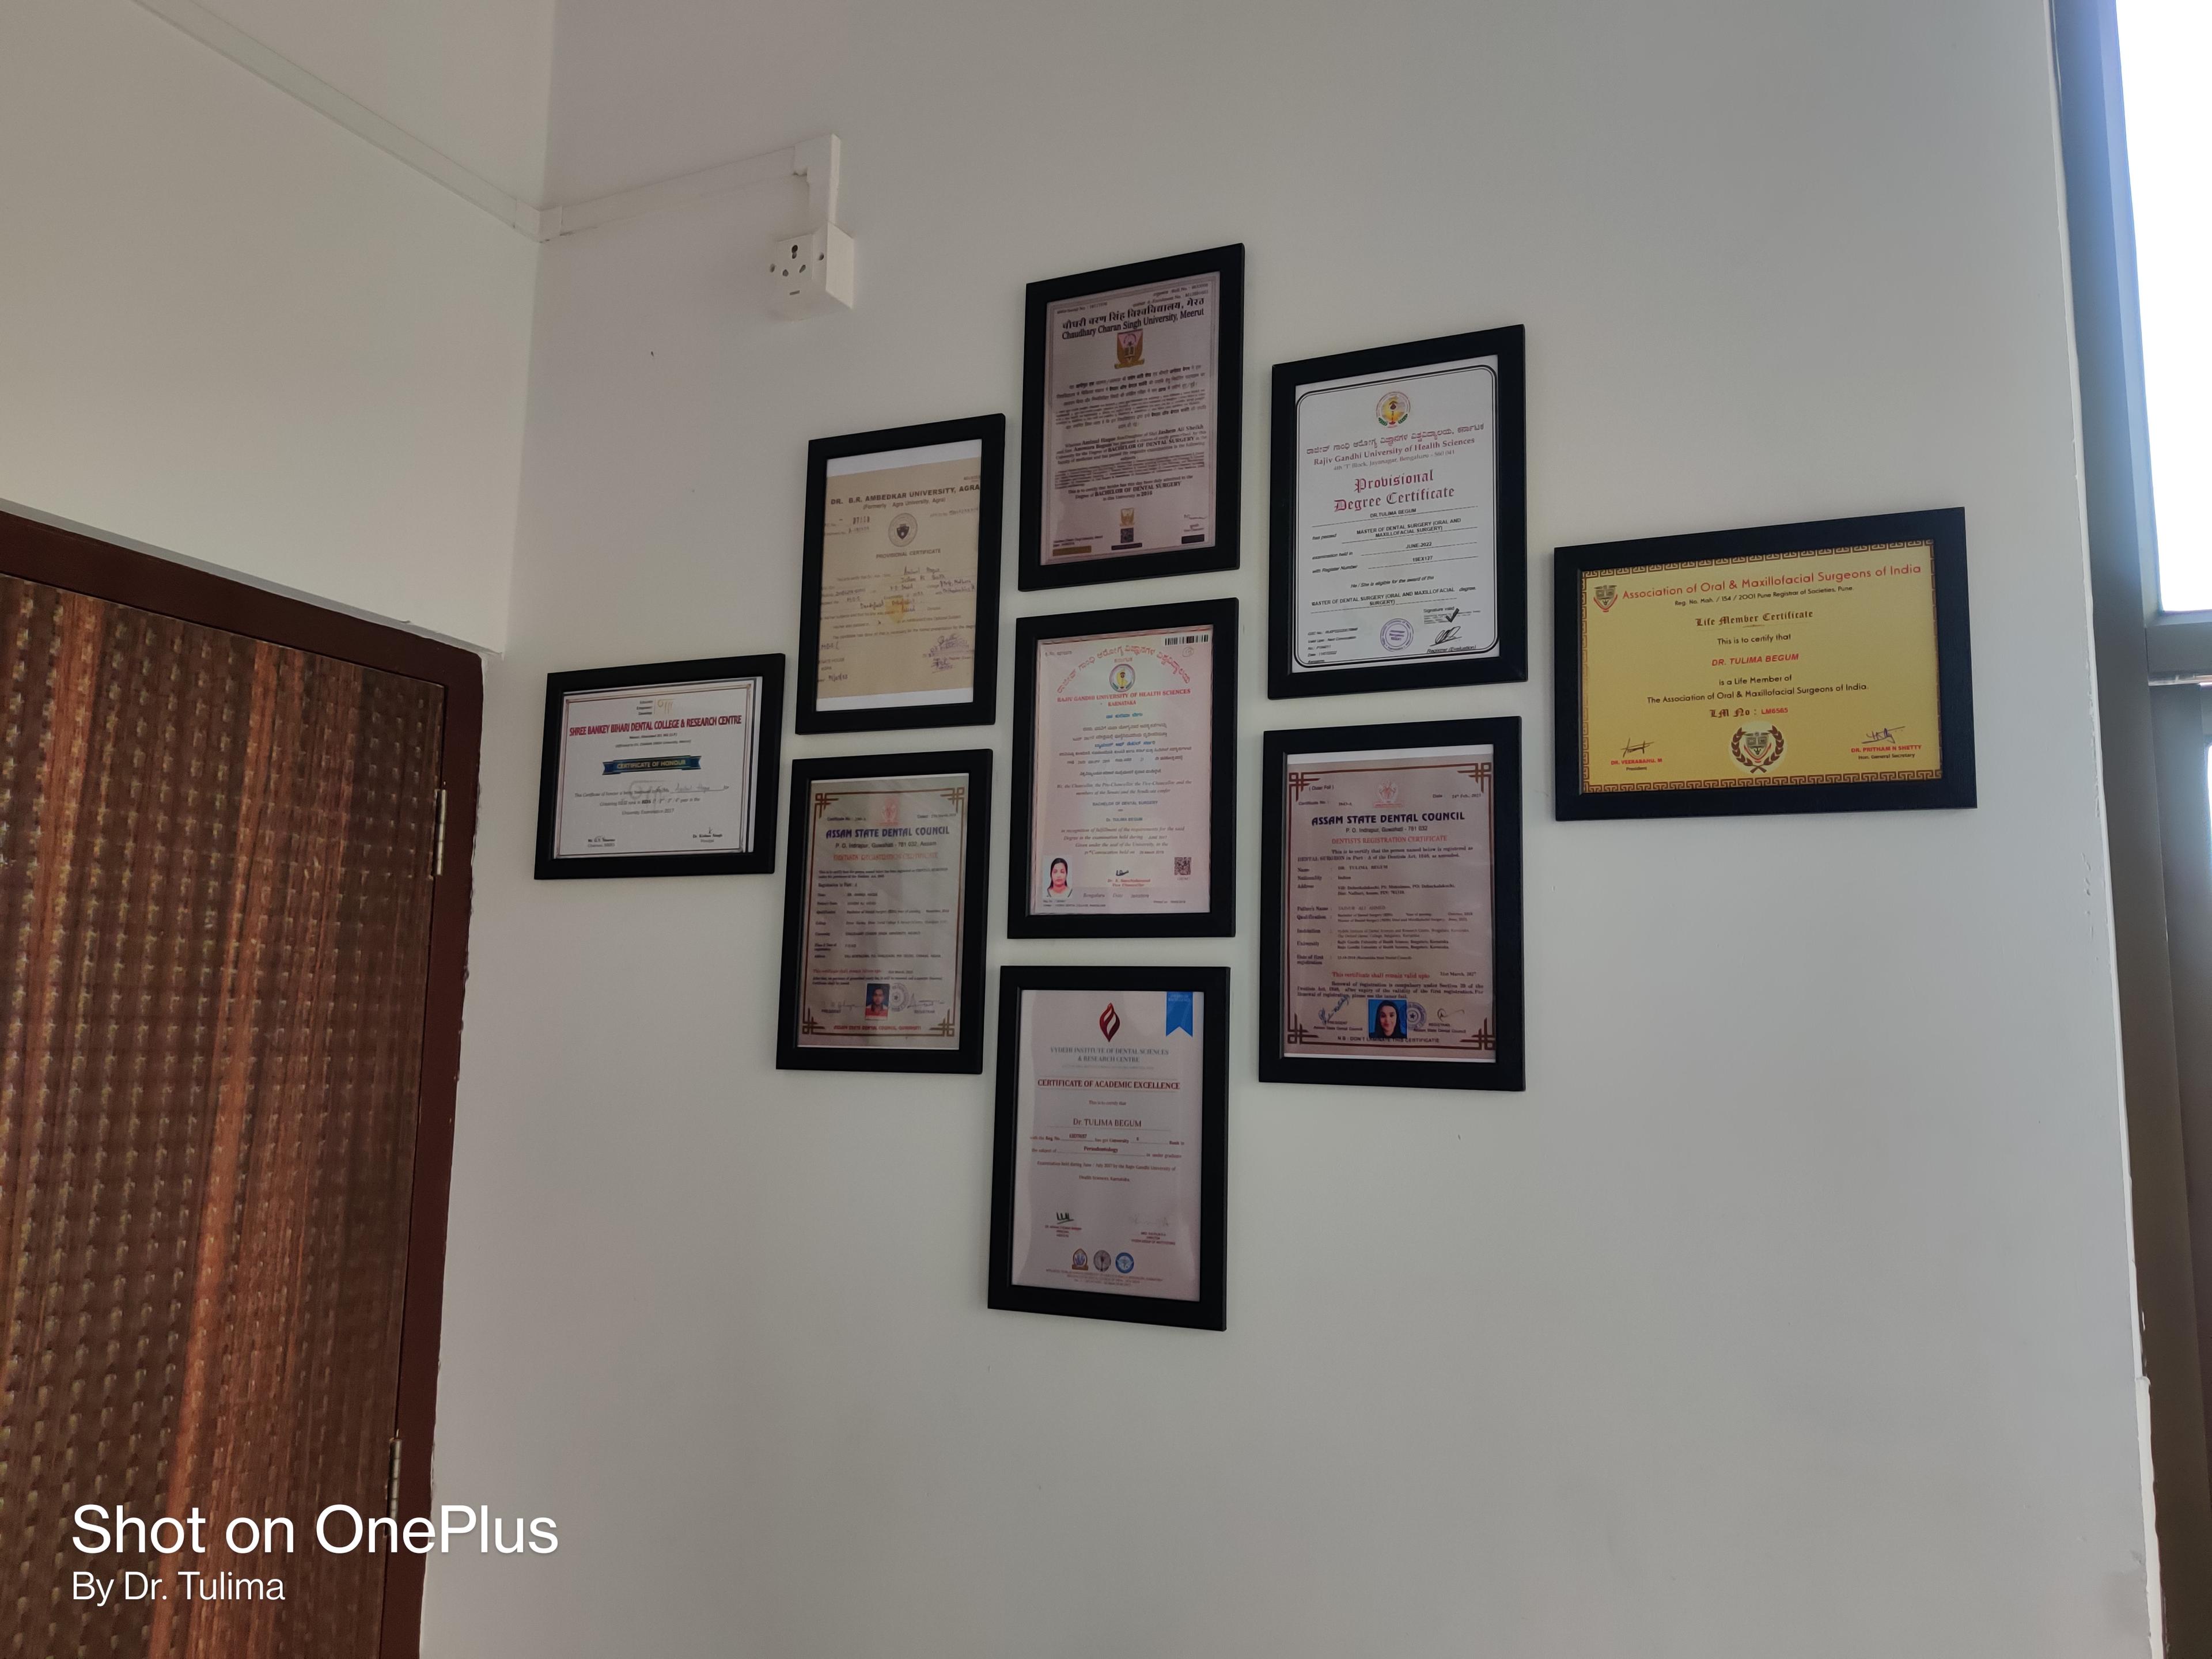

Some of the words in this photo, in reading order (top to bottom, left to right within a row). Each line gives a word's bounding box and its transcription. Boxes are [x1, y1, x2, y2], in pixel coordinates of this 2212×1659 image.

[1622, 585, 1683, 600] Association
[1685, 582, 1697, 593] of
[1699, 579, 1725, 592] Oral
[1728, 579, 1738, 590] &
[1741, 571, 1814, 589] Maxillofacial
[1817, 570, 1872, 583] Surgeons
[1874, 565, 1887, 577] of
[1889, 563, 1921, 575] India
[1772, 590, 1798, 599] Registrar
[1695, 617, 1715, 626] Life
[1718, 614, 1759, 626] Member
[1762, 610, 1813, 622] Certificate
[1717, 637, 1732, 645] This
[1750, 634, 1774, 643] certify
[1775, 632, 1791, 641] that
[1729, 655, 1763, 665] TULIMA
[1764, 653, 1799, 662] BEGUM
[1733, 676, 1748, 685] Life
[1749, 675, 1782, 684] Member
[1783, 673, 1792, 681] of
[1662, 694, 1705, 703] Association
[1706, 691, 1715, 700] of
[1716, 690, 1734, 699] Oral
[1736, 690, 1743, 698] &
[1744, 686, 1795, 698] Maxillofacial
[1796, 686, 1834, 696] Surgeons
[1835, 683, 1843, 692] of
[1709, 708, 1729, 718] LM
[1732, 707, 1750, 717] No
[1311, 815, 1343, 826] ASSAM
[1346, 815, 1377, 824] STATE
[1380, 813, 1419, 823] DENTAL
[1421, 811, 1465, 821] COUNCIL
[825, 828, 852, 839] ASSAM
[854, 828, 879, 838] STATE
[881, 827, 912, 837] DENTAL
[914, 825, 949, 836] COUNCIL
[1362, 836, 1407, 844] REGISTRATION
[1407, 834, 1447, 842] CERTIFICATE
